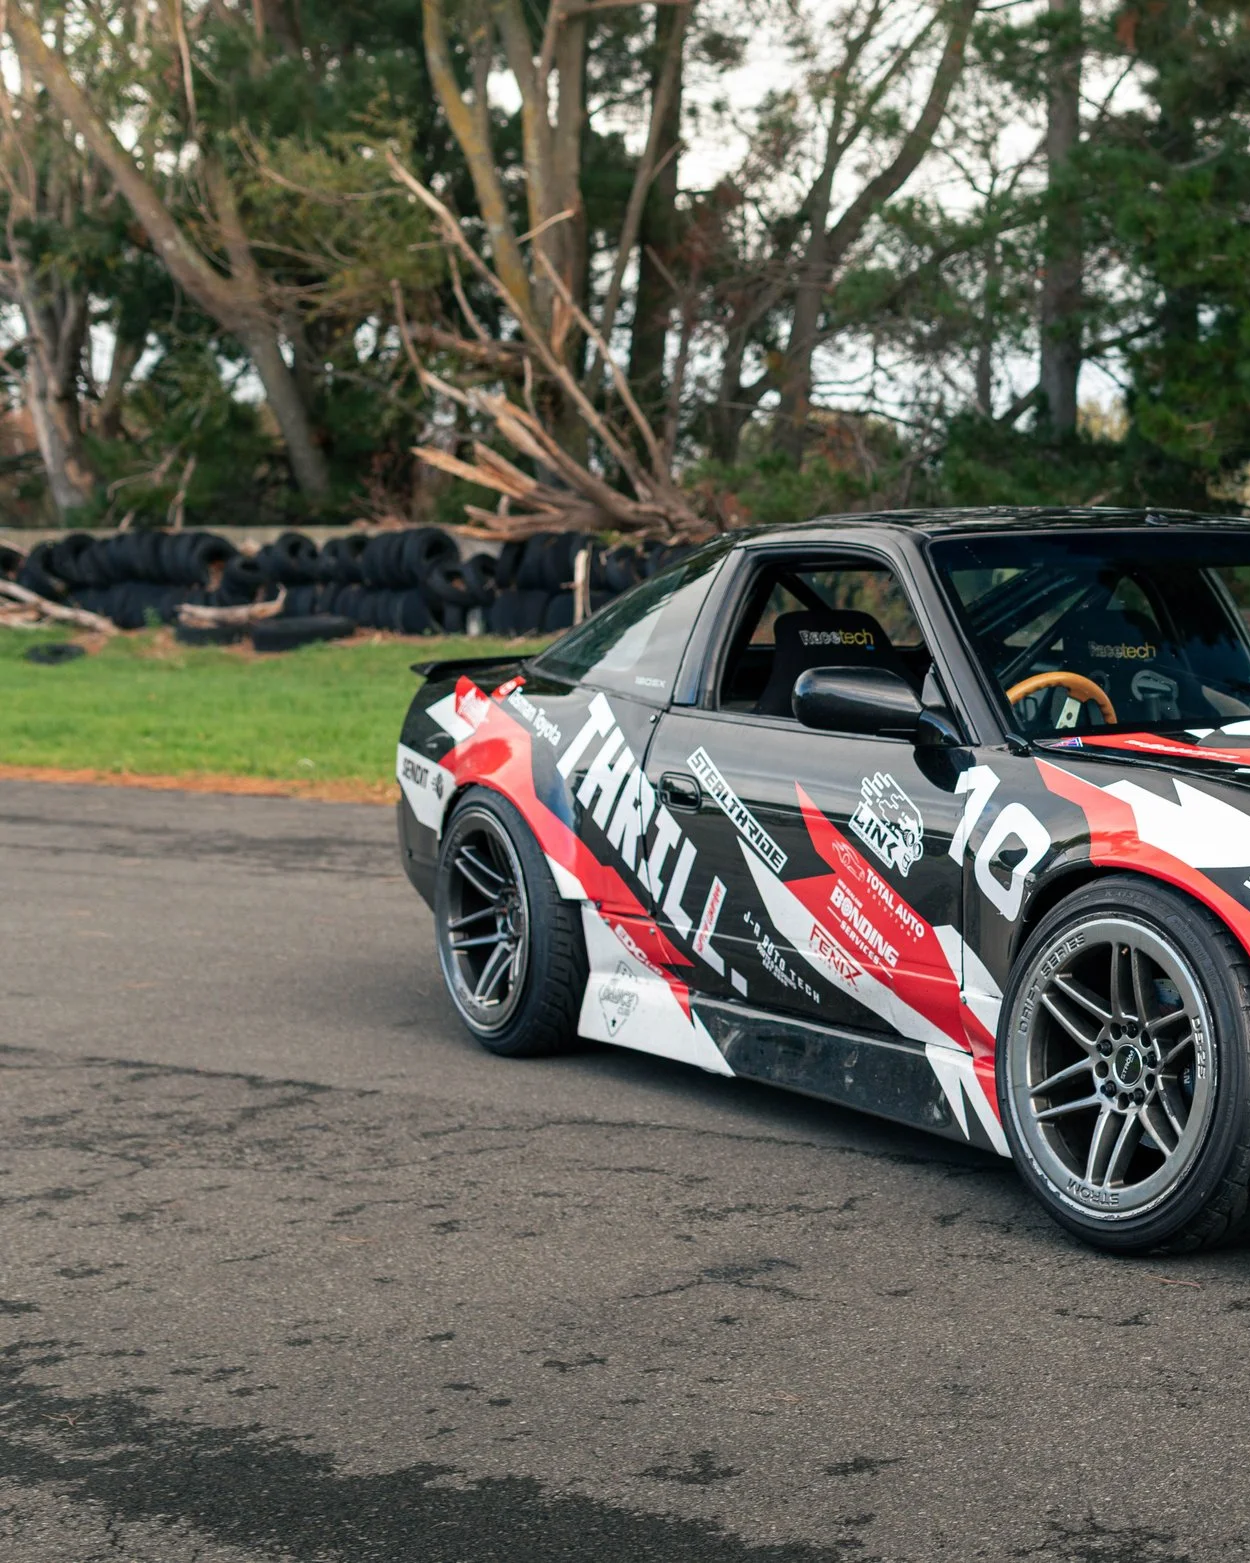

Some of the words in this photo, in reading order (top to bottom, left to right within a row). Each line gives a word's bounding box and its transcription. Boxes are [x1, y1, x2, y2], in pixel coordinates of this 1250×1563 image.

[799, 628, 874, 645] Racetech
[533, 707, 563, 746] Toyota
[690, 751, 785, 870] STEALTHRIDE
[852, 804, 899, 862] LINK
[948, 765, 1052, 922] 10
[830, 884, 900, 968] BONDING
[866, 868, 895, 911] TOTAL
[894, 903, 925, 938] AUTO
[839, 919, 880, 966] SERVICES
[789, 968, 820, 1004] TECH
[1018, 978, 1041, 1037] DRIFT
[1040, 932, 1085, 980] SERIES
